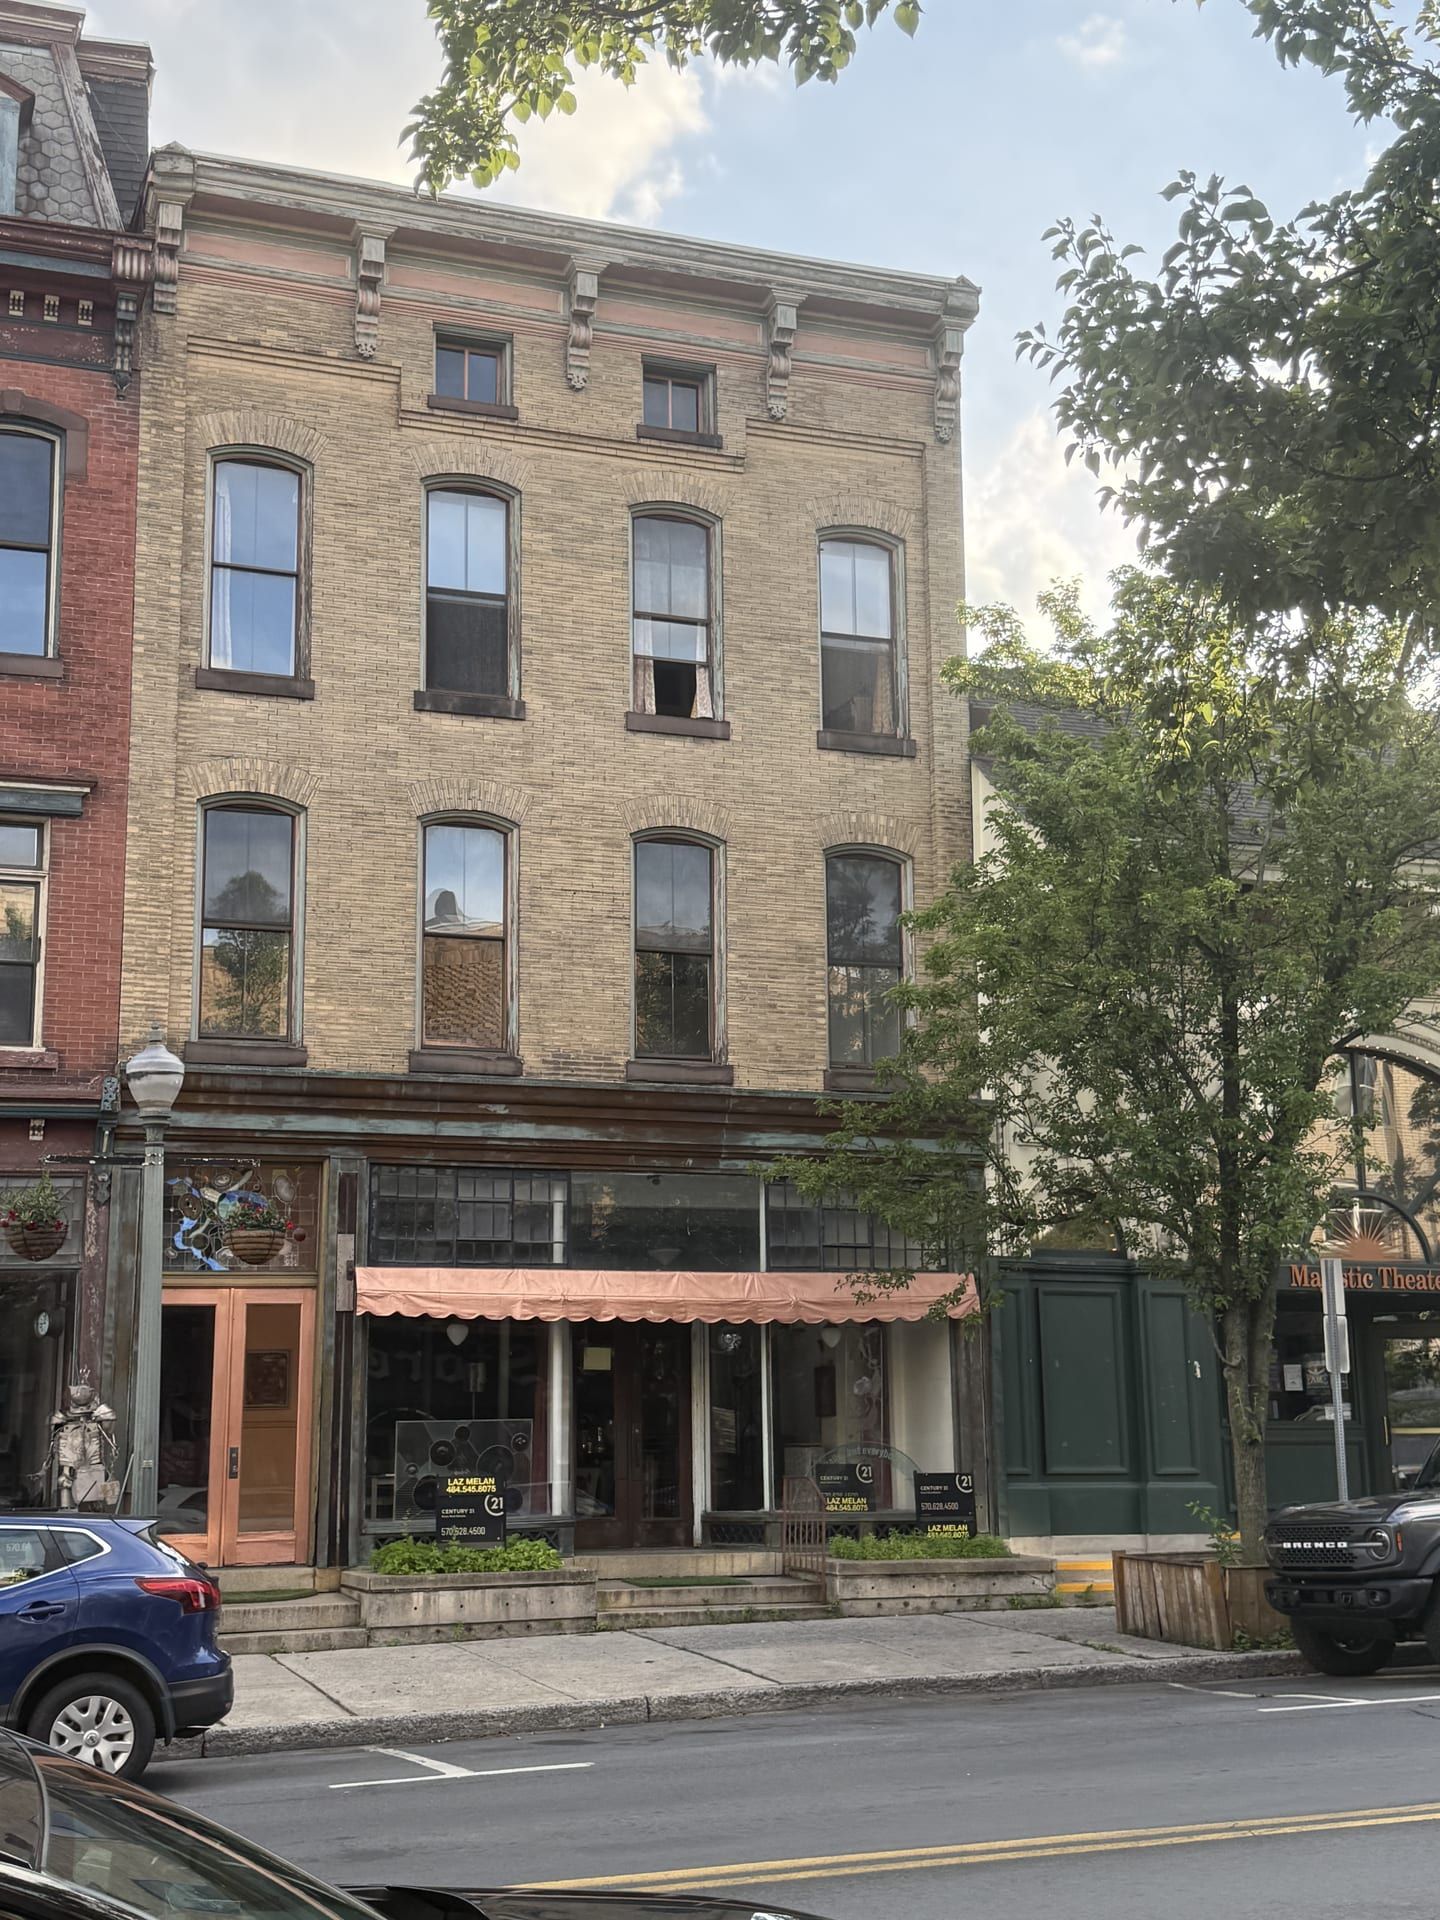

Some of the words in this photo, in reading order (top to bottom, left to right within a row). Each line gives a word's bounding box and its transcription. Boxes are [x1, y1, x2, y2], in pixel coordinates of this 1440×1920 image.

[1290, 1263, 1374, 1289] Mastic
[447, 1478, 464, 1486] LAZ
[466, 1477, 495, 1485] MELAN
[827, 1497, 840, 1505] LAZ
[841, 1497, 867, 1505] MELAN
[927, 1524, 941, 1532] LAZ
[1282, 1541, 1348, 1549] BRONCO
